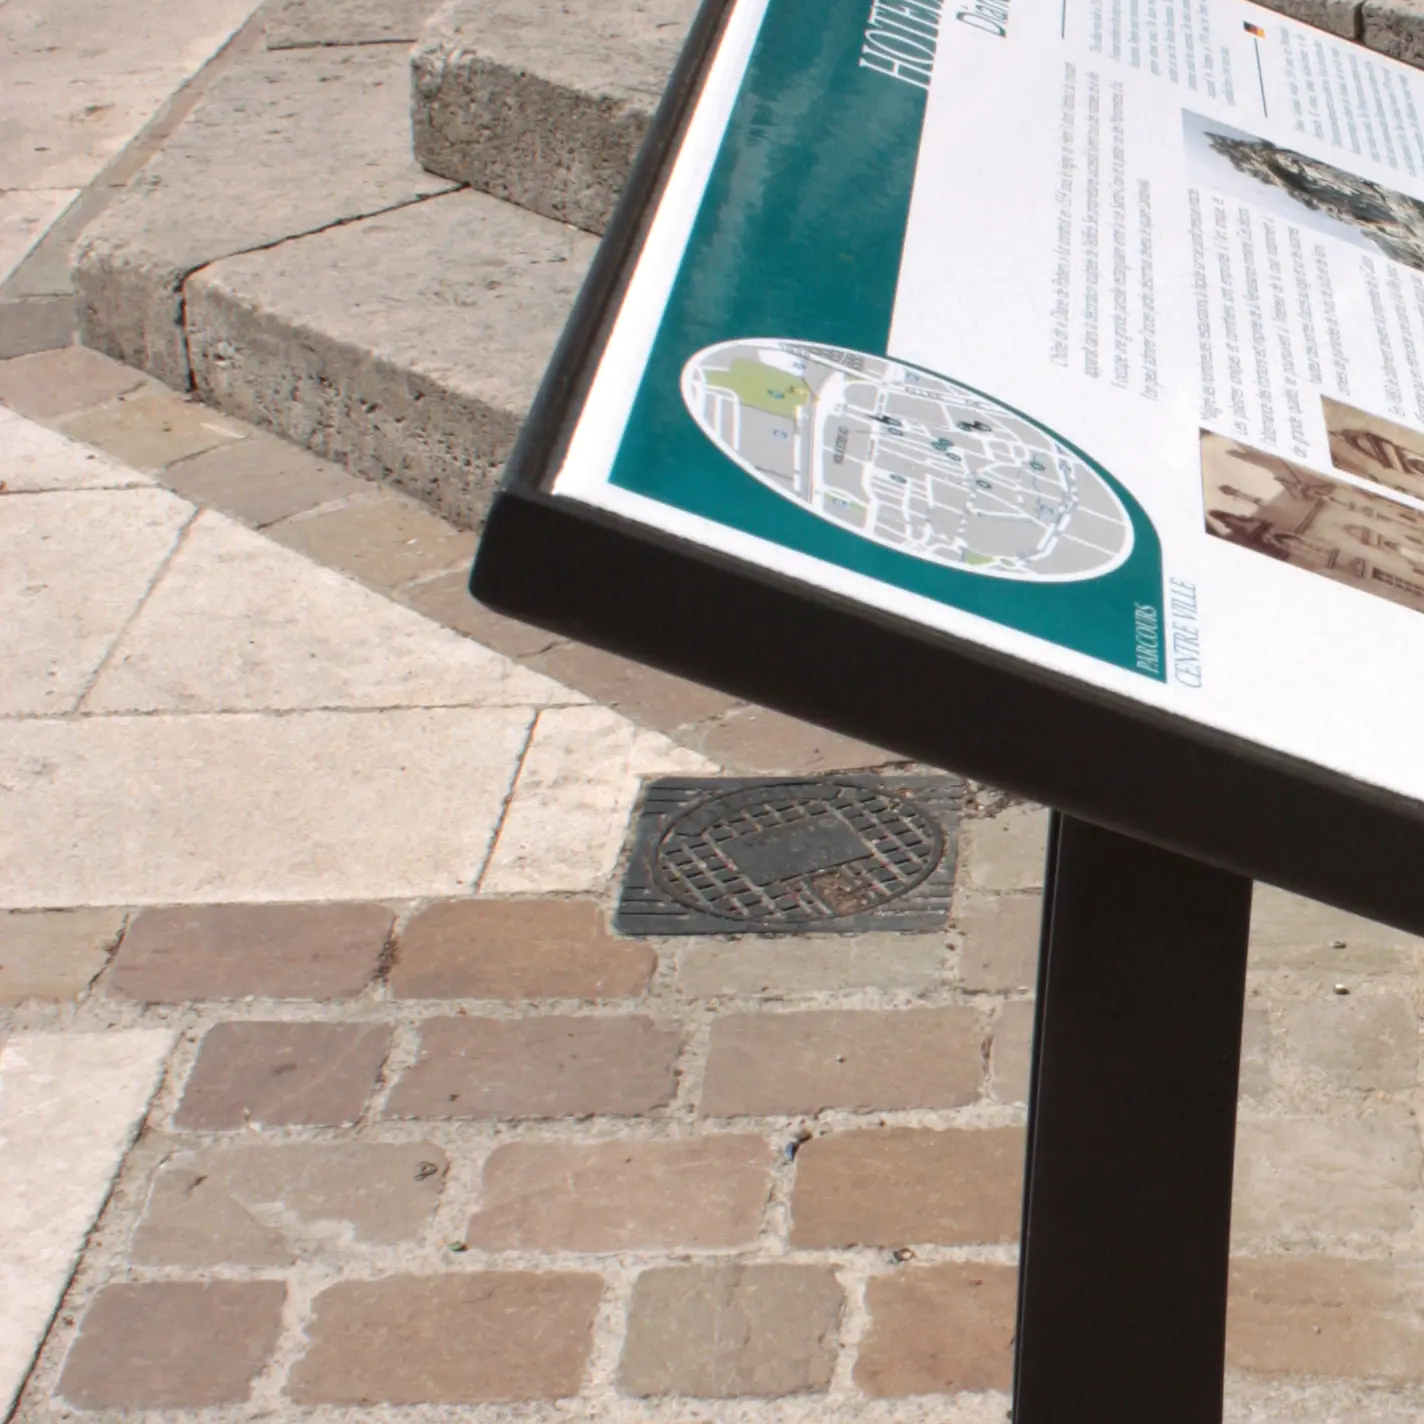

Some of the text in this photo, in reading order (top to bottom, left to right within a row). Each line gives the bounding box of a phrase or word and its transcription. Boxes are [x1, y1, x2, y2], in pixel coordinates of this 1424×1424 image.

[1136, 602, 1160, 676] PARCOURS
[1170, 577, 1202, 690] CENTRE VILLE
